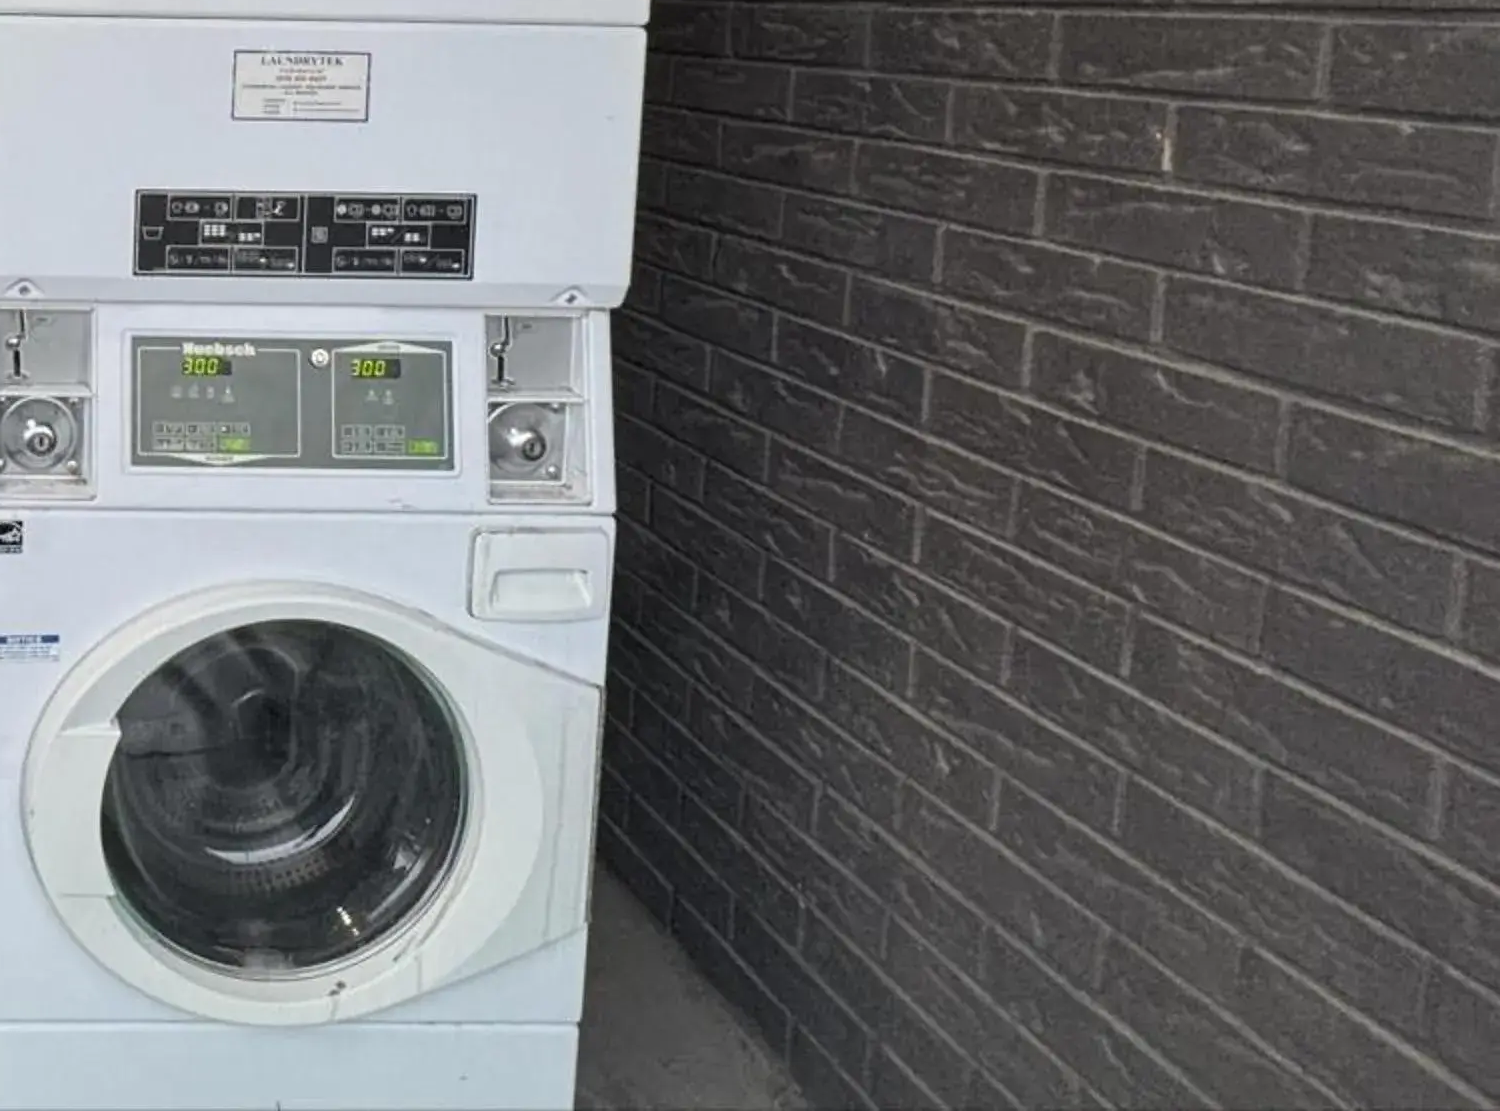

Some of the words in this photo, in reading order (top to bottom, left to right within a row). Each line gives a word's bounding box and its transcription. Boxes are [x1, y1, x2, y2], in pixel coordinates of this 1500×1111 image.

[261, 56, 344, 66] LAUNDRYTEK
[182, 357, 219, 375] 300
[350, 358, 387, 376] 300
